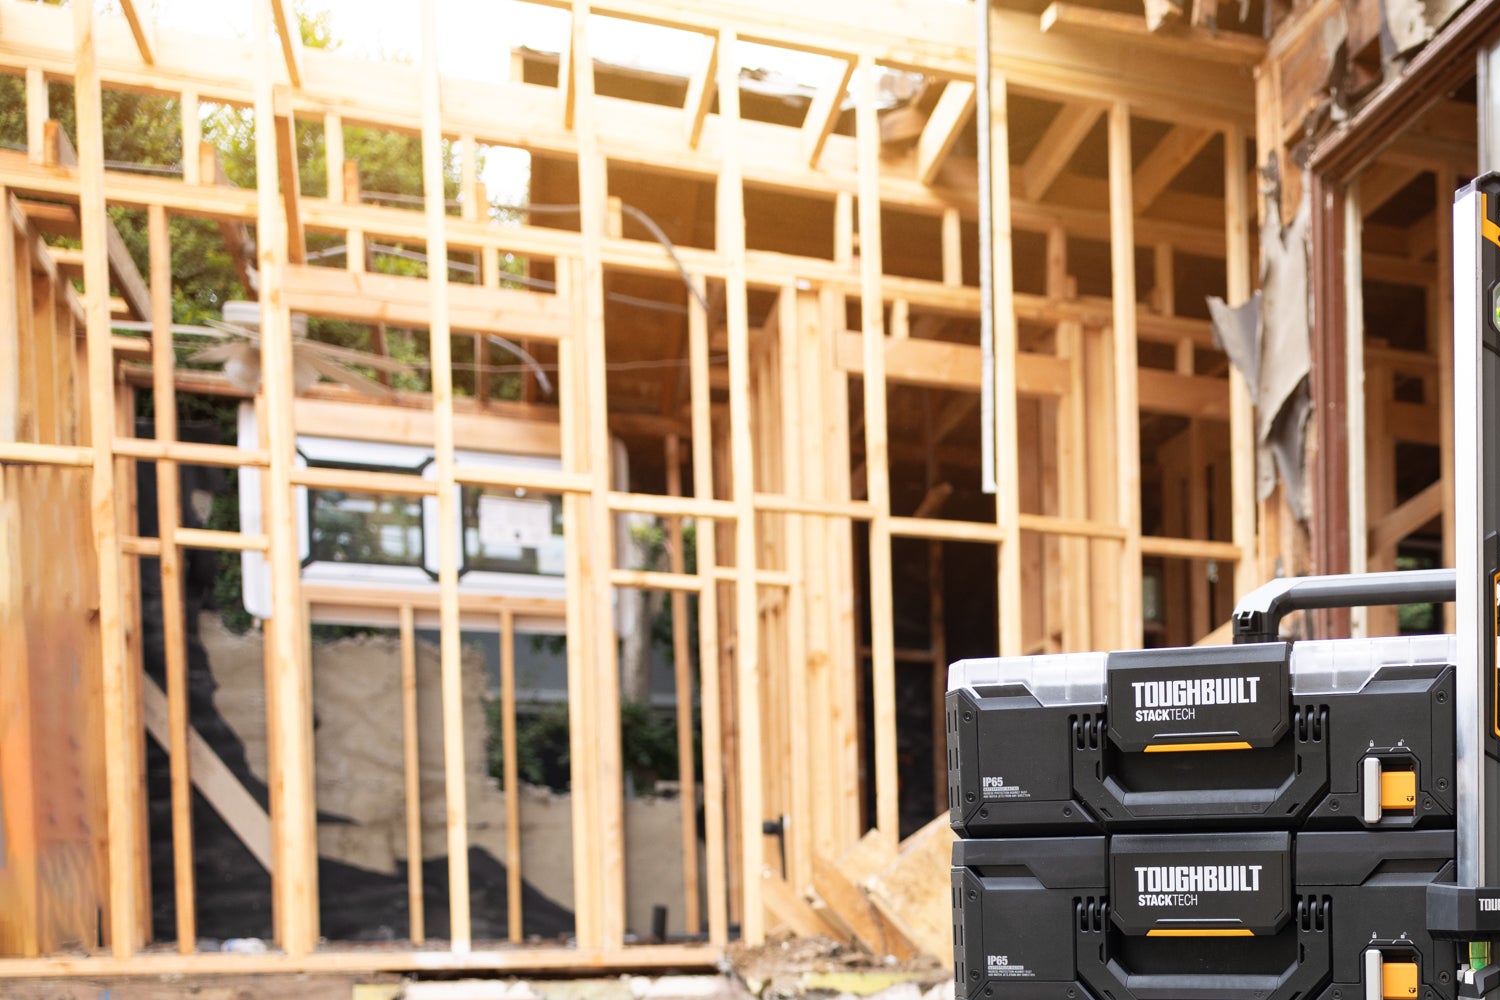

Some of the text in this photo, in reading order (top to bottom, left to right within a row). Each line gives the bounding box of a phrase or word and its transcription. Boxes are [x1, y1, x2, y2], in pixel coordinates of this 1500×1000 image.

[1131, 676, 1261, 708] TOUGHBUILT
[1135, 708, 1196, 722] STACKTECH
[982, 776, 1004, 787] IP65
[1134, 865, 1263, 893] TOUGHBUILT
[1138, 894, 1198, 907] STACKTECH
[987, 955, 1009, 966] IP65
